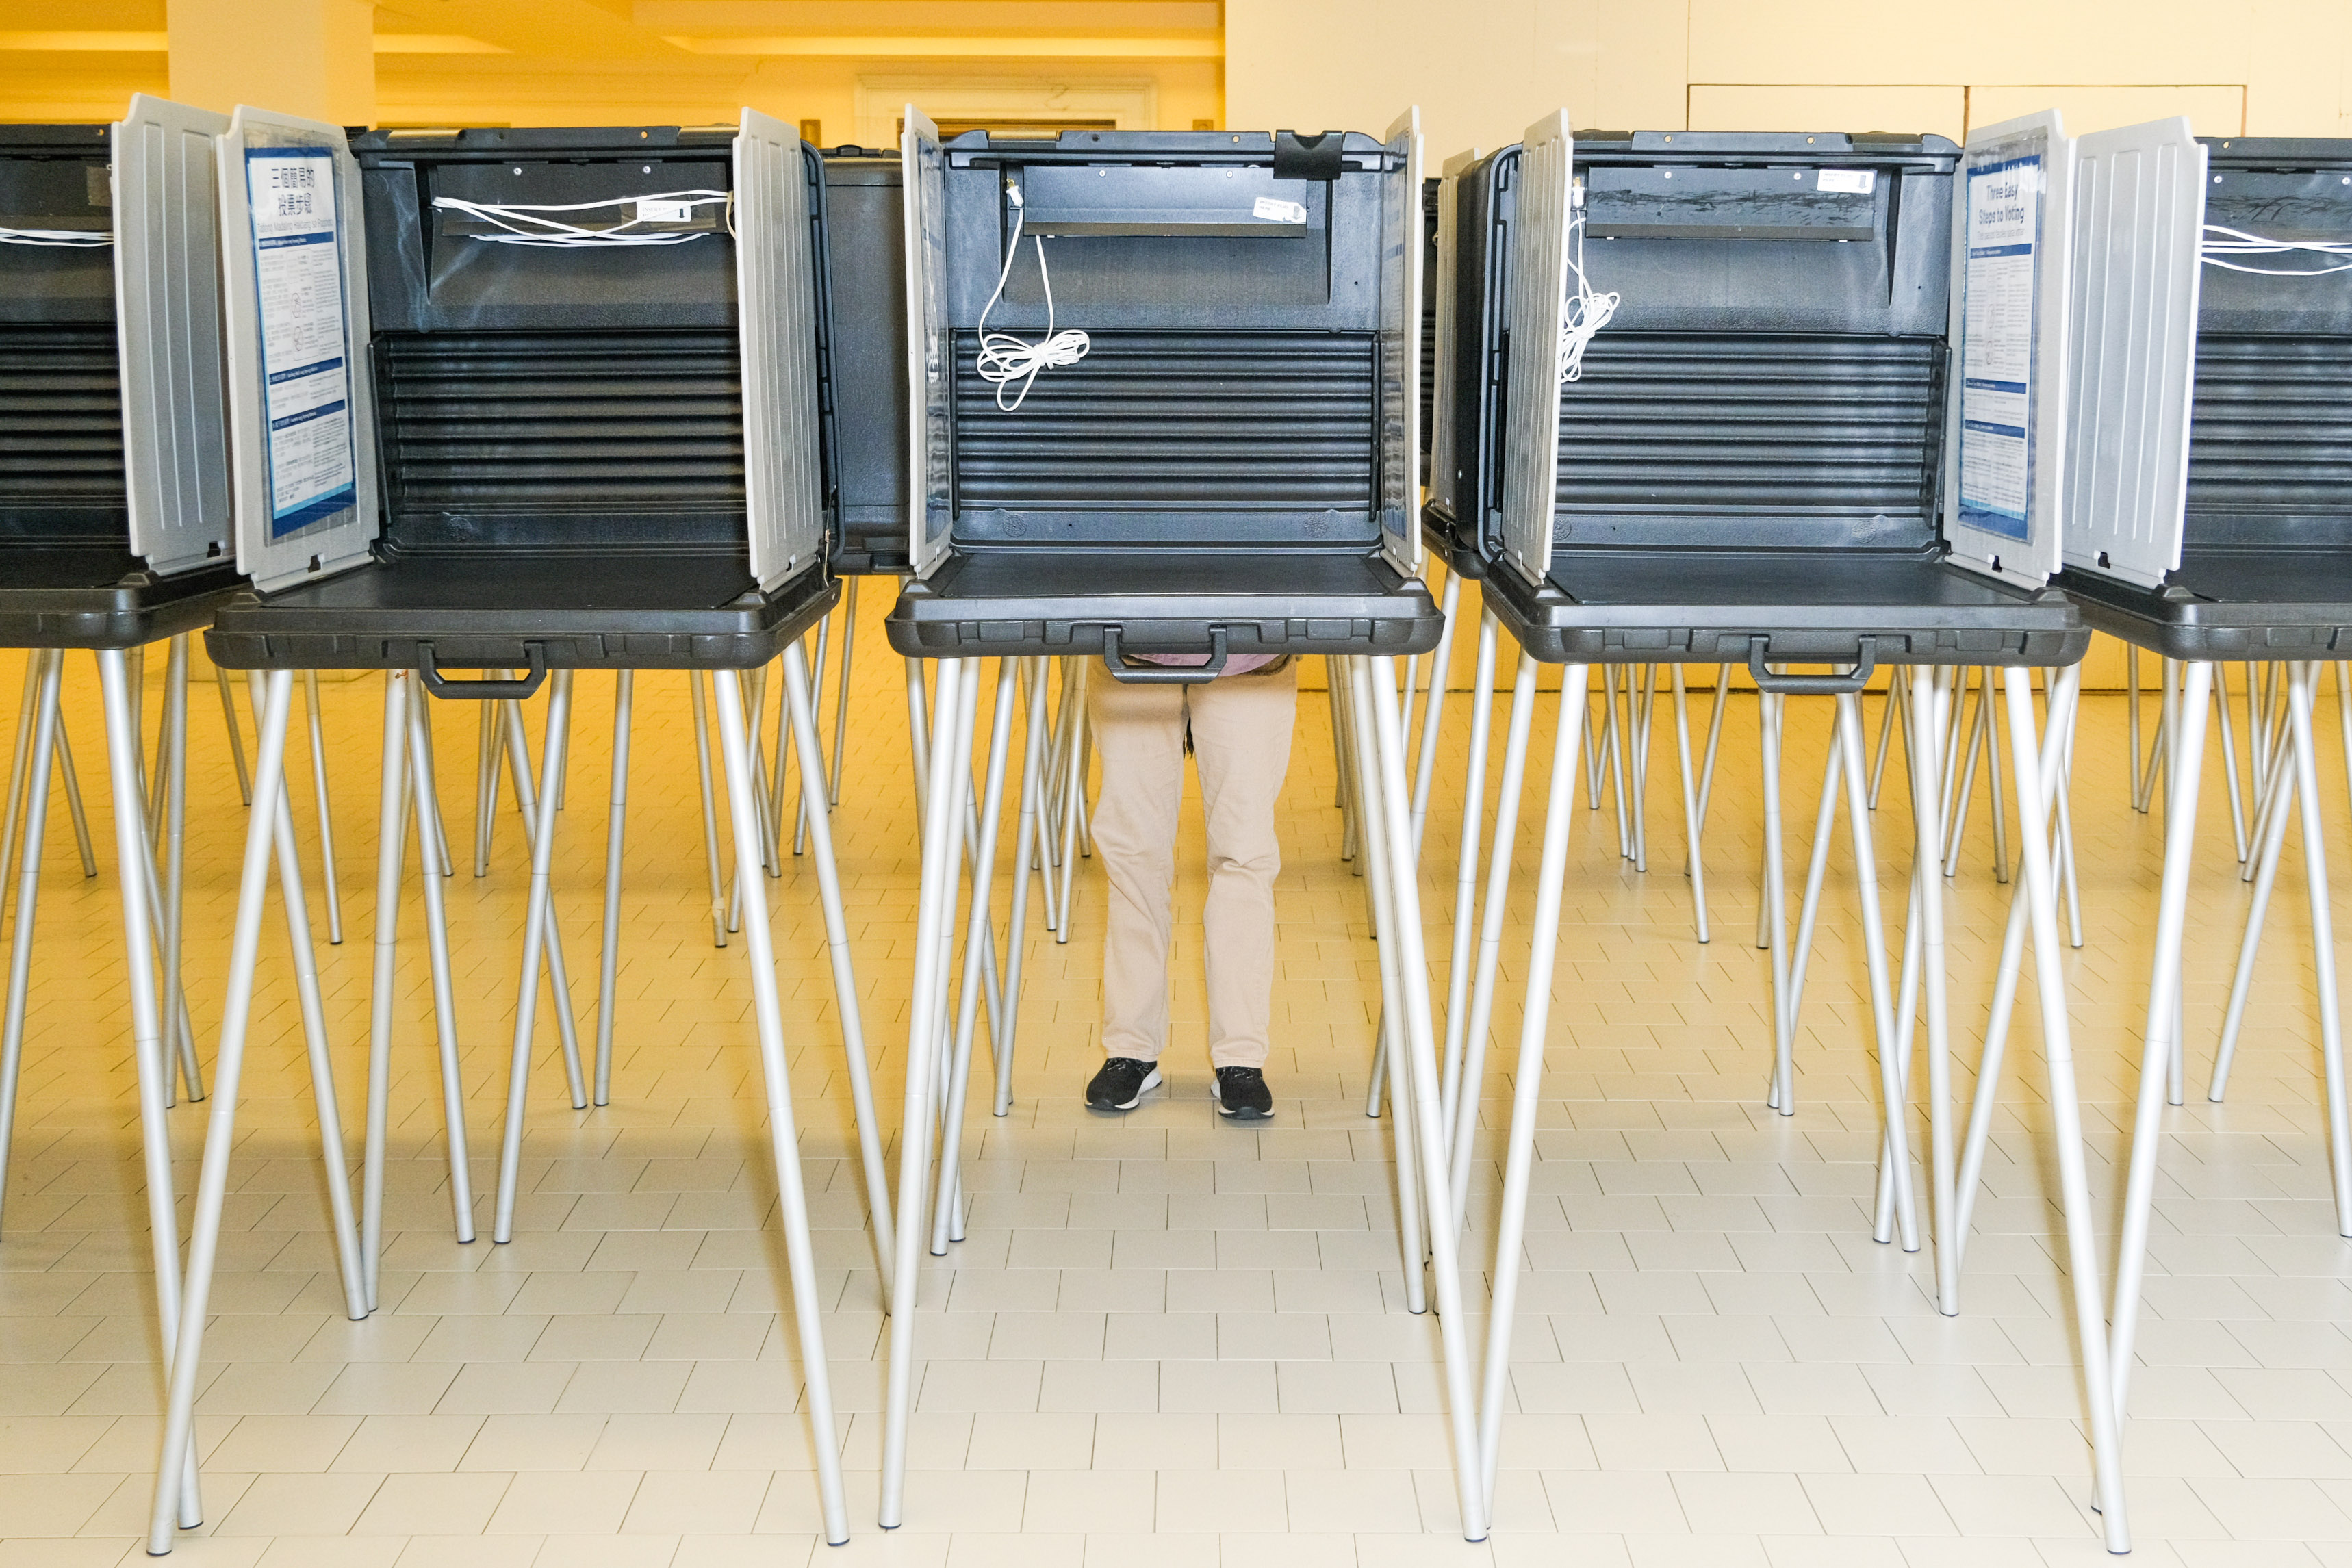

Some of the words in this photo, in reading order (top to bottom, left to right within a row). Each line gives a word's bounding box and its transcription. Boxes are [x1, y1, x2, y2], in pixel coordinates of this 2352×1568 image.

[271, 167, 314, 188] 三個簡易的
[1986, 185, 2003, 201] Three
[2004, 182, 2018, 201] Easy
[278, 192, 312, 216] 投票步驟
[1979, 209, 1995, 228] Steps
[1997, 208, 2003, 222] to
[2004, 204, 2024, 224] Voting
